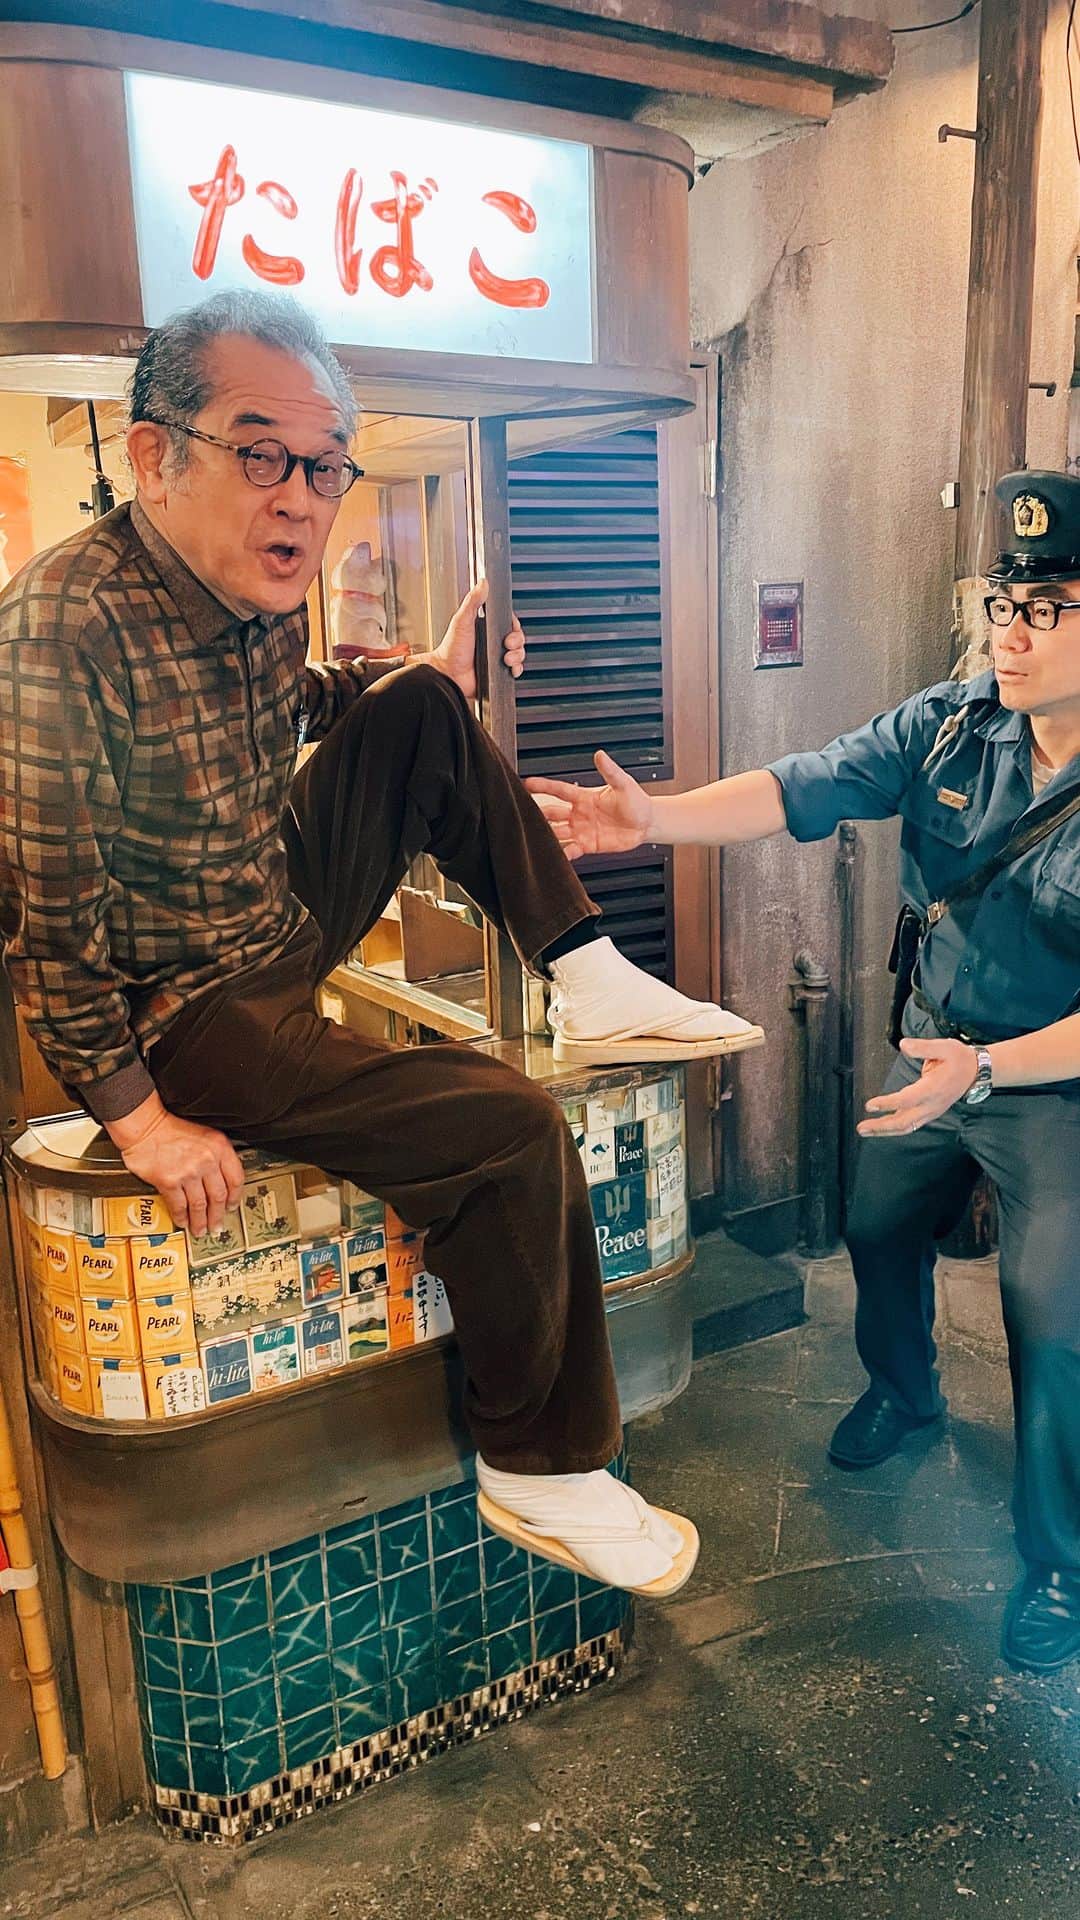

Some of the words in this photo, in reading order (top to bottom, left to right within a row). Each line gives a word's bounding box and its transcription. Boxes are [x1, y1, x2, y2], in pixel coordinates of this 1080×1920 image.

[188, 144, 550, 308] たばこ
[619, 1146, 642, 1162] Peace
[140, 1198, 154, 1226] PEARL
[595, 1226, 645, 1260] Peace
[47, 1245, 66, 1263] PEARL
[82, 1255, 113, 1269] PEARL
[139, 1256, 174, 1270] PEARL
[55, 1306, 76, 1323] PEARL
[147, 1316, 181, 1330] PEARL
[88, 1318, 119, 1332] PEARL
[62, 1367, 82, 1384] PEARL
[208, 1364, 249, 1387] hi-lite
